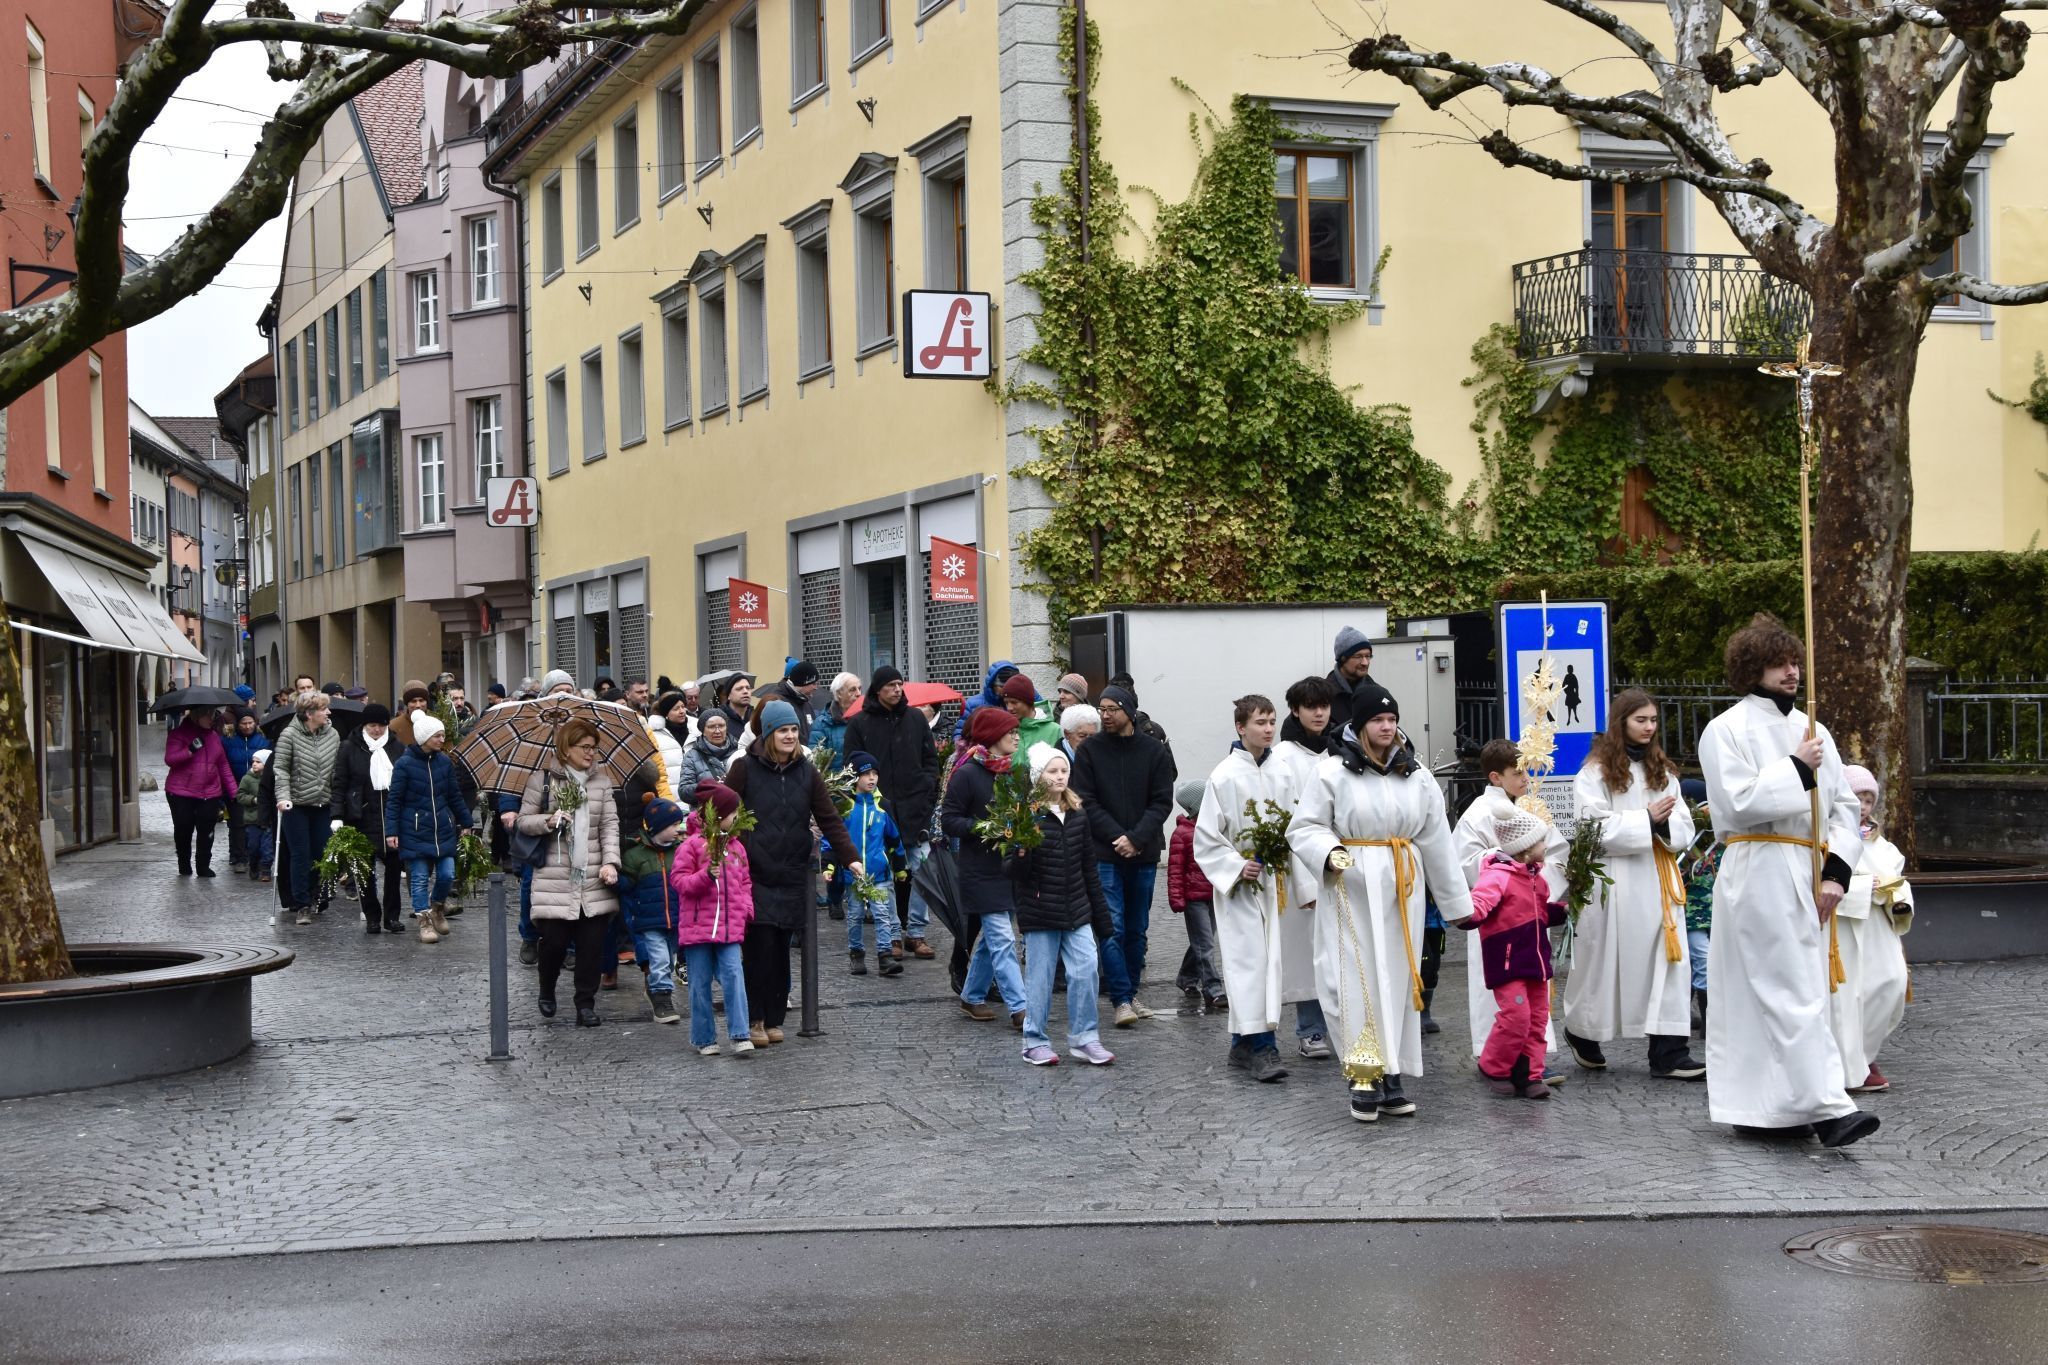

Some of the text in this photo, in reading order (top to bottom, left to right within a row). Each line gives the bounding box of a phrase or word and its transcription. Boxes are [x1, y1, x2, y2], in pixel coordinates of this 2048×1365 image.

[872, 525, 904, 544] APOTHEKE
[940, 586, 969, 594] Achtung
[935, 592, 974, 600] Dachlawine
[1556, 793, 1566, 801] bis
[1556, 802, 1566, 810] bis
